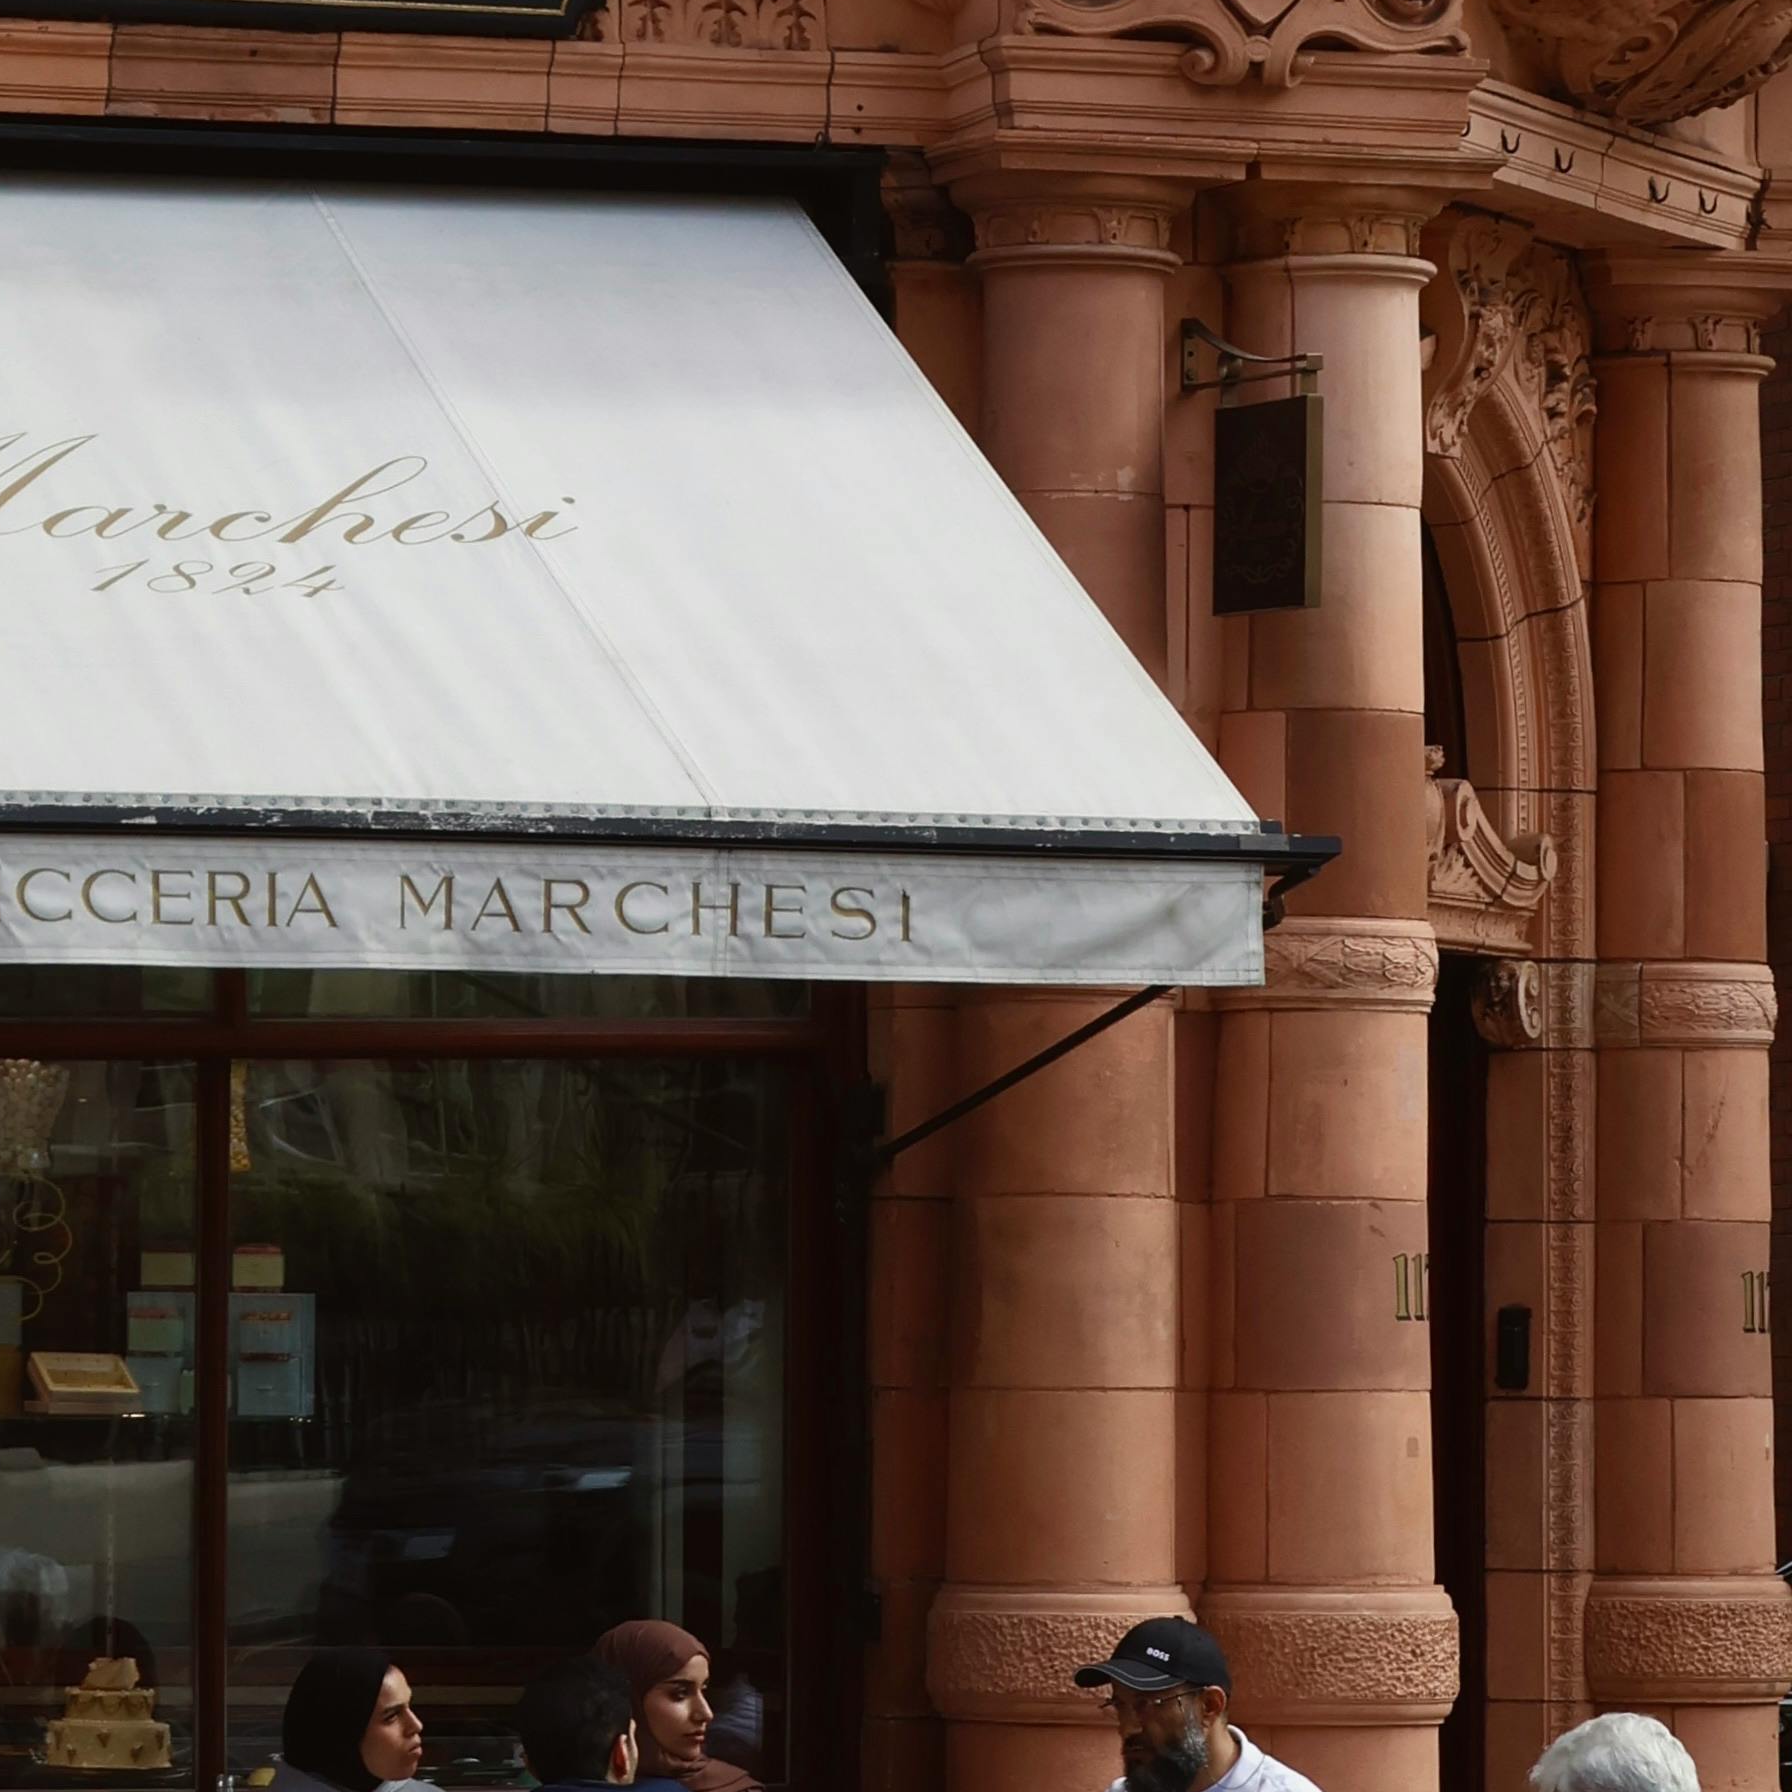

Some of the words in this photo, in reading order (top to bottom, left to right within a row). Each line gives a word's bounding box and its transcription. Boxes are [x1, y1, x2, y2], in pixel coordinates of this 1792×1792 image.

[89, 559, 347, 599] 1824
[399, 872, 914, 945] MARCHESI
[1145, 1646, 1170, 1662] BOSS
